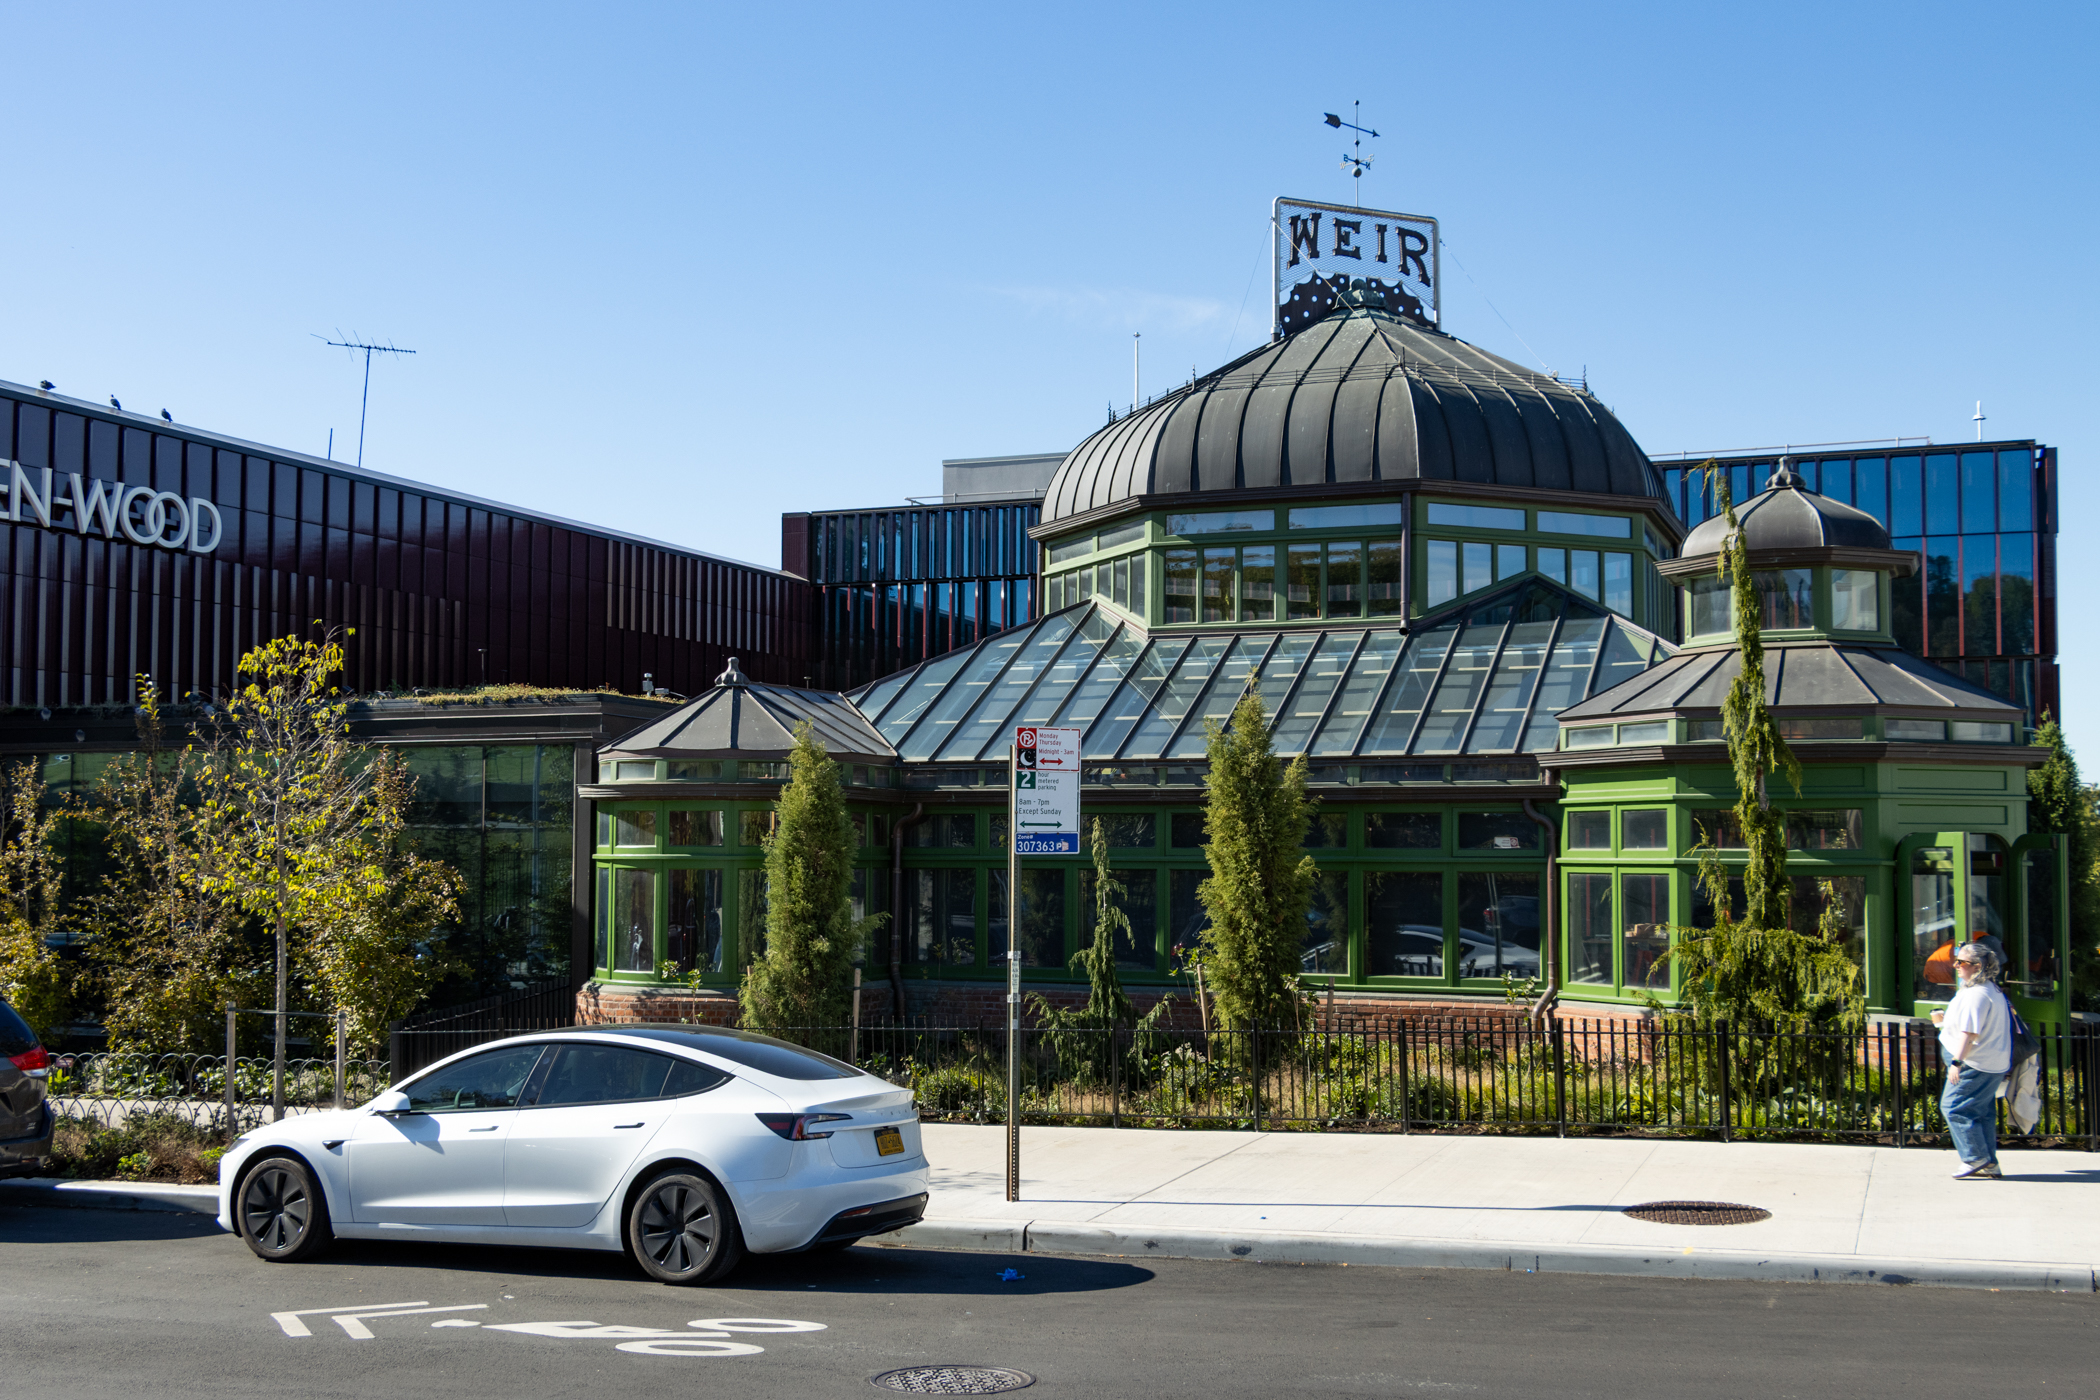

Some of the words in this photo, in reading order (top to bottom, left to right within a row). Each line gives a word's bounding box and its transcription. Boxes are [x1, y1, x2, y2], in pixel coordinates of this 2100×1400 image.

[1287, 212, 1431, 287] WEIR
[1020, 772, 1031, 788] 2
[1040, 808, 1062, 816] Sunday
[1017, 840, 1055, 852] 307363
